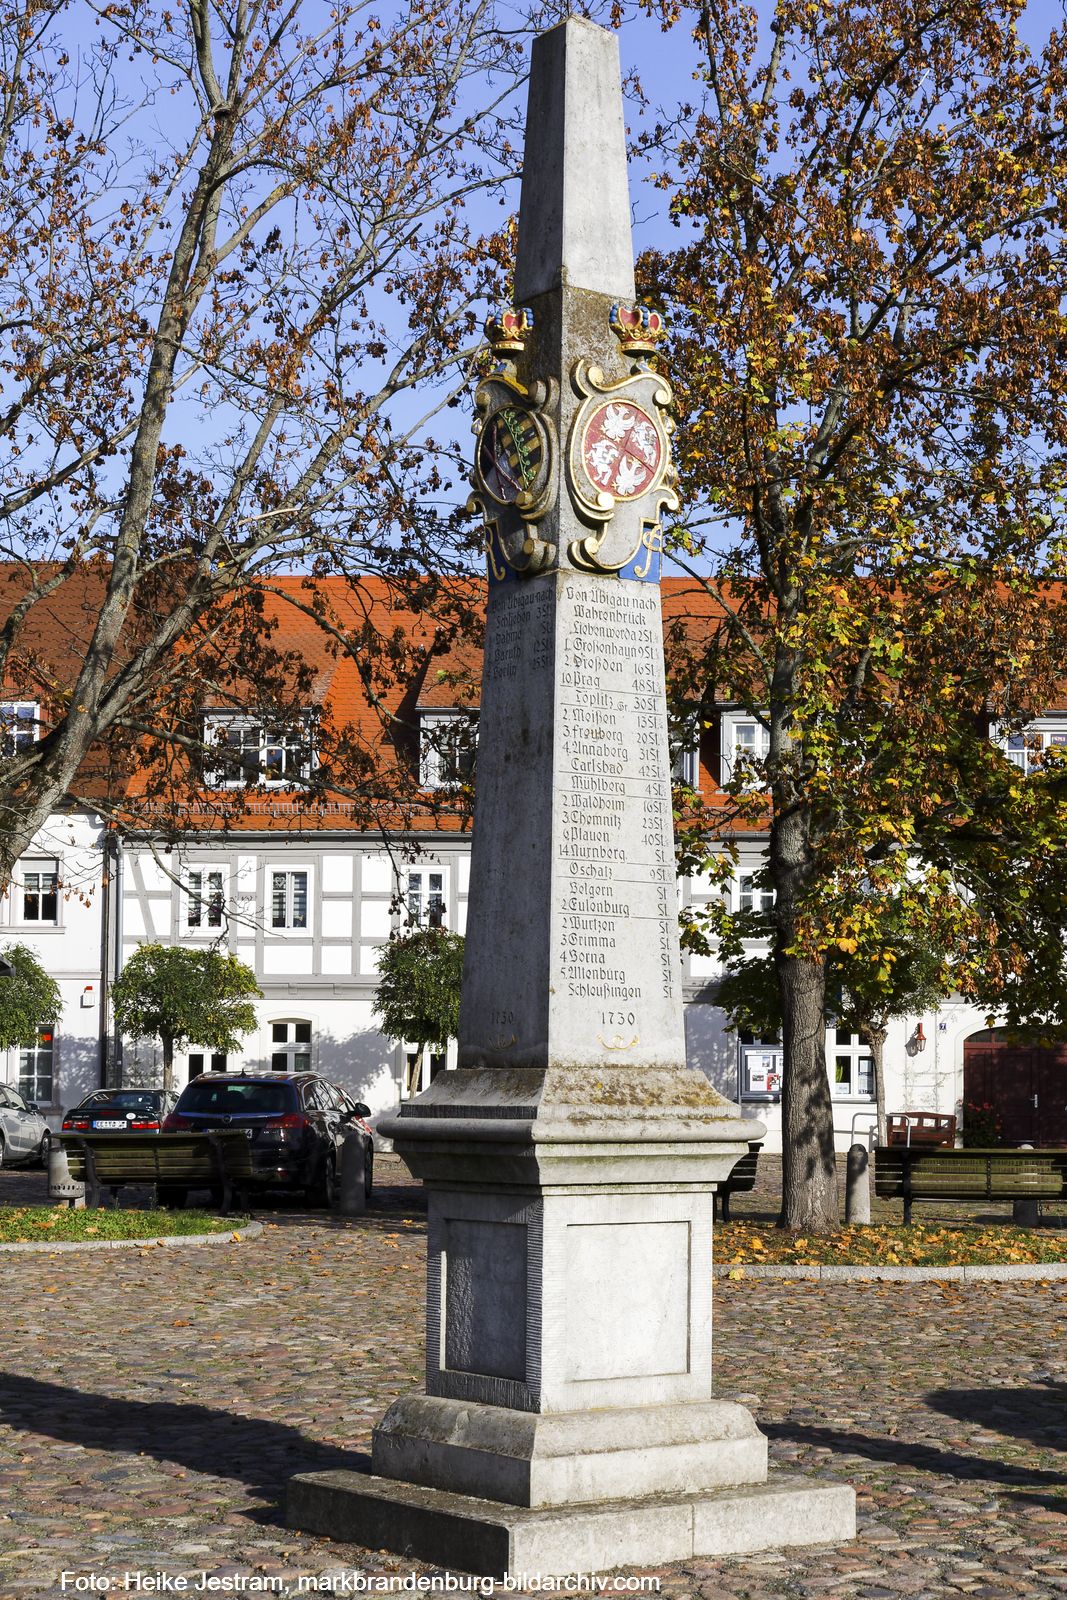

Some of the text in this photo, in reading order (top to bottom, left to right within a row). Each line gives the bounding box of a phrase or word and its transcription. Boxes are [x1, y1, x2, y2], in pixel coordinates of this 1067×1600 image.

[566, 586, 587, 602] Von
[632, 598, 656, 610] nach
[574, 605, 646, 626] Wahrenbrück
[570, 620, 636, 640] Liebenwerda
[574, 671, 600, 688] Prag
[572, 741, 628, 762] Annaberg
[570, 758, 623, 774] Carlsbad
[571, 775, 626, 796] Mühlberg
[571, 794, 624, 811] Waldheim
[571, 810, 621, 830] Chemnitz
[571, 827, 610, 842] Plauen
[570, 861, 612, 880] Oschatz
[570, 916, 614, 934] Wurtzen
[569, 932, 616, 948] Grimma
[569, 949, 606, 964] Borna
[568, 966, 626, 984] Altenburg
[602, 1011, 636, 1026] 1730
